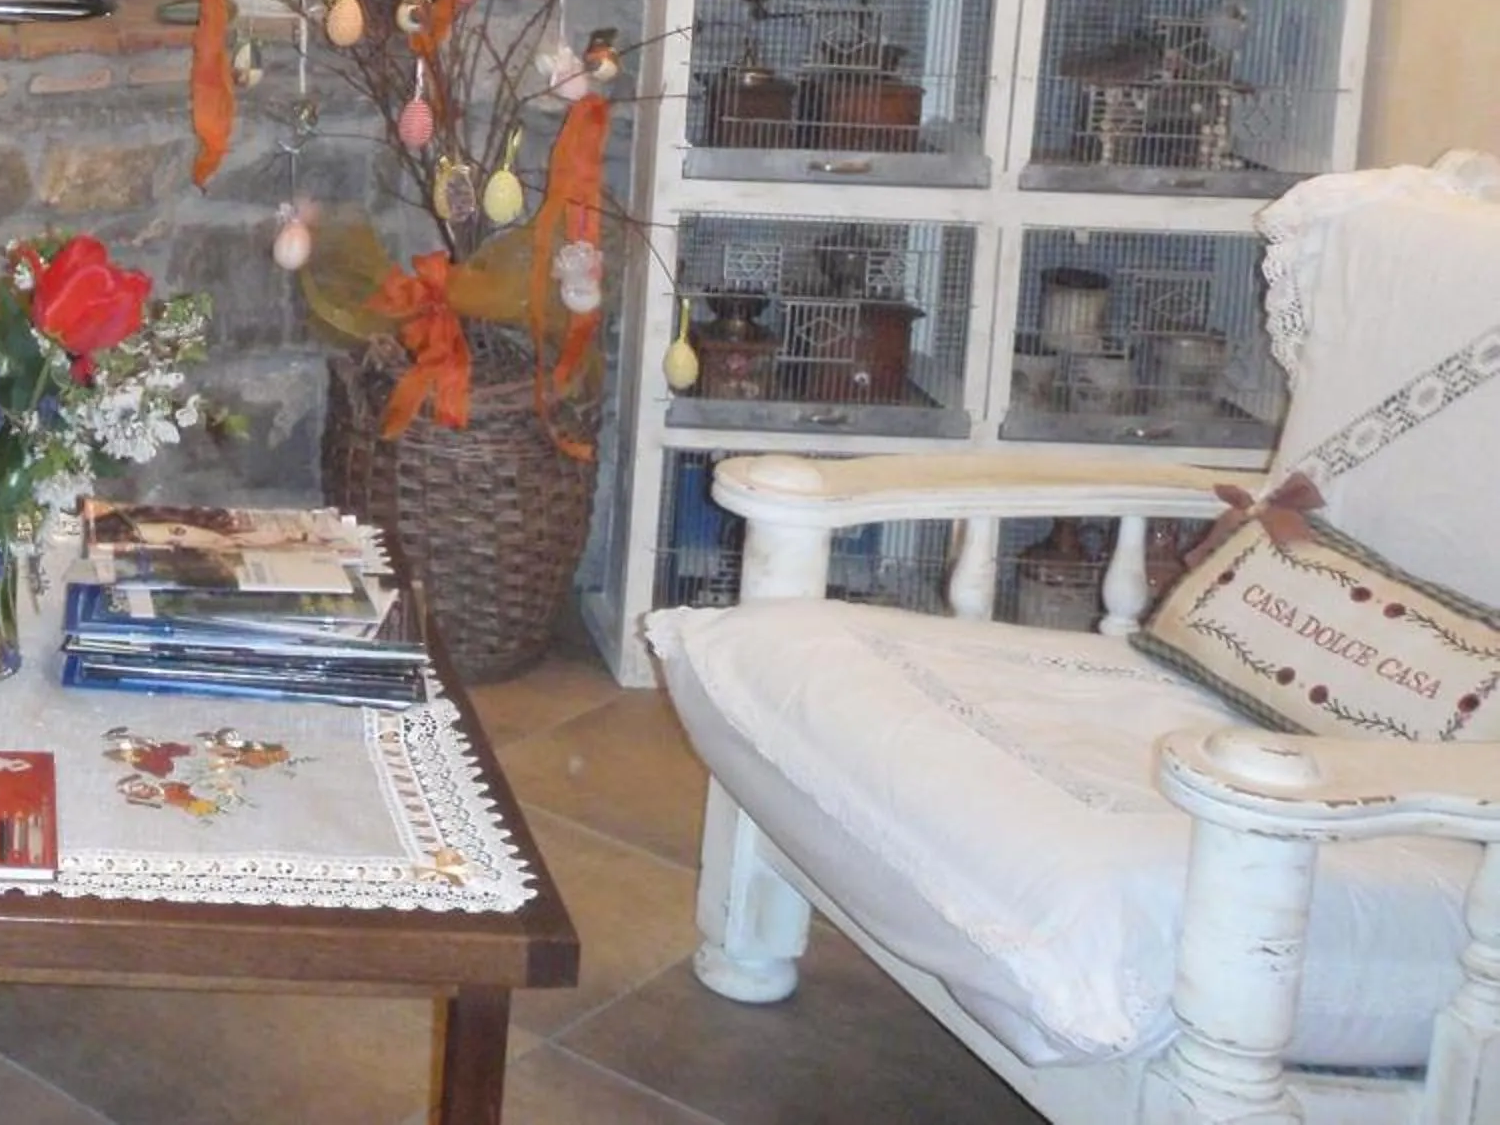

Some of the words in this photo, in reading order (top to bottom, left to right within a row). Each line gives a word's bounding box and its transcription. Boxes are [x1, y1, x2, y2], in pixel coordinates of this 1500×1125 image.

[1242, 583, 1299, 629] CASA
[1298, 615, 1378, 667] DOLCE
[1376, 658, 1442, 699] CASA
